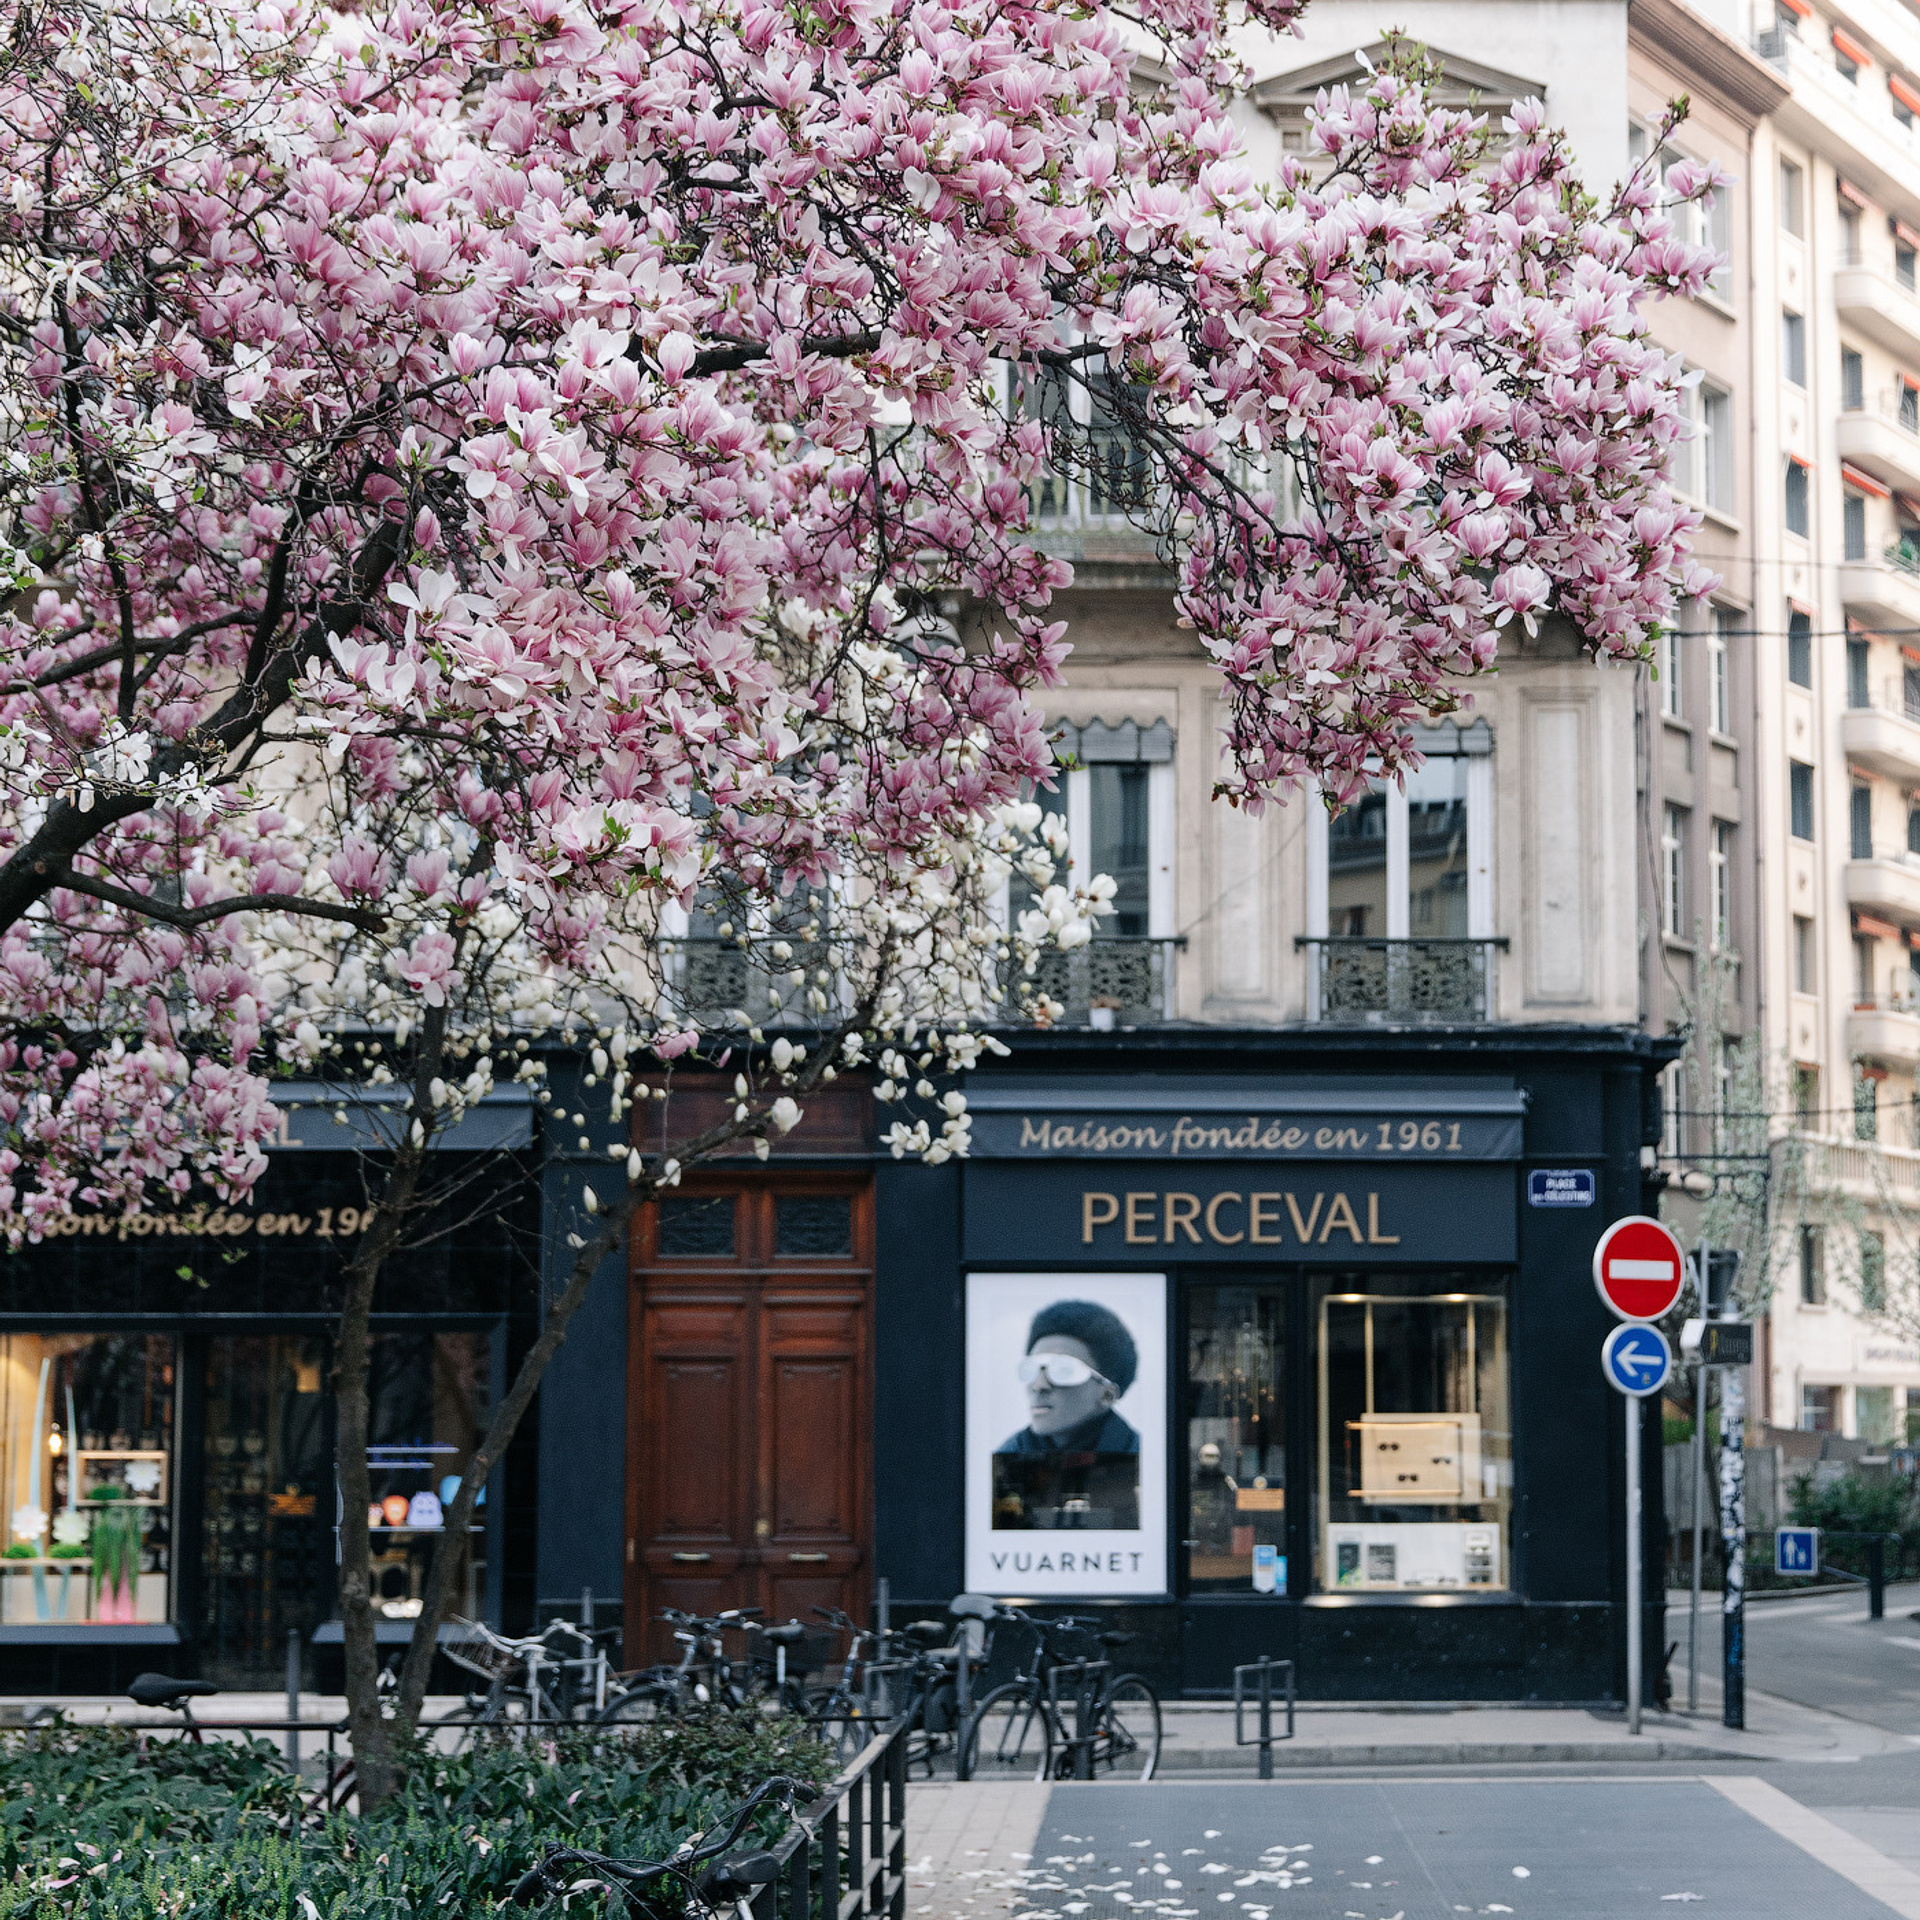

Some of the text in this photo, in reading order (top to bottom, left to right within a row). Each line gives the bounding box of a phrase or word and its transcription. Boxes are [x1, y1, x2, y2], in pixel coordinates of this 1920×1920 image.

[1019, 1116, 1463, 1155] Maison fondée en 1961
[256, 1212, 312, 1236] en
[1082, 1191, 1401, 1244] PERCEVAL
[991, 1551, 1143, 1573] VUARNET
